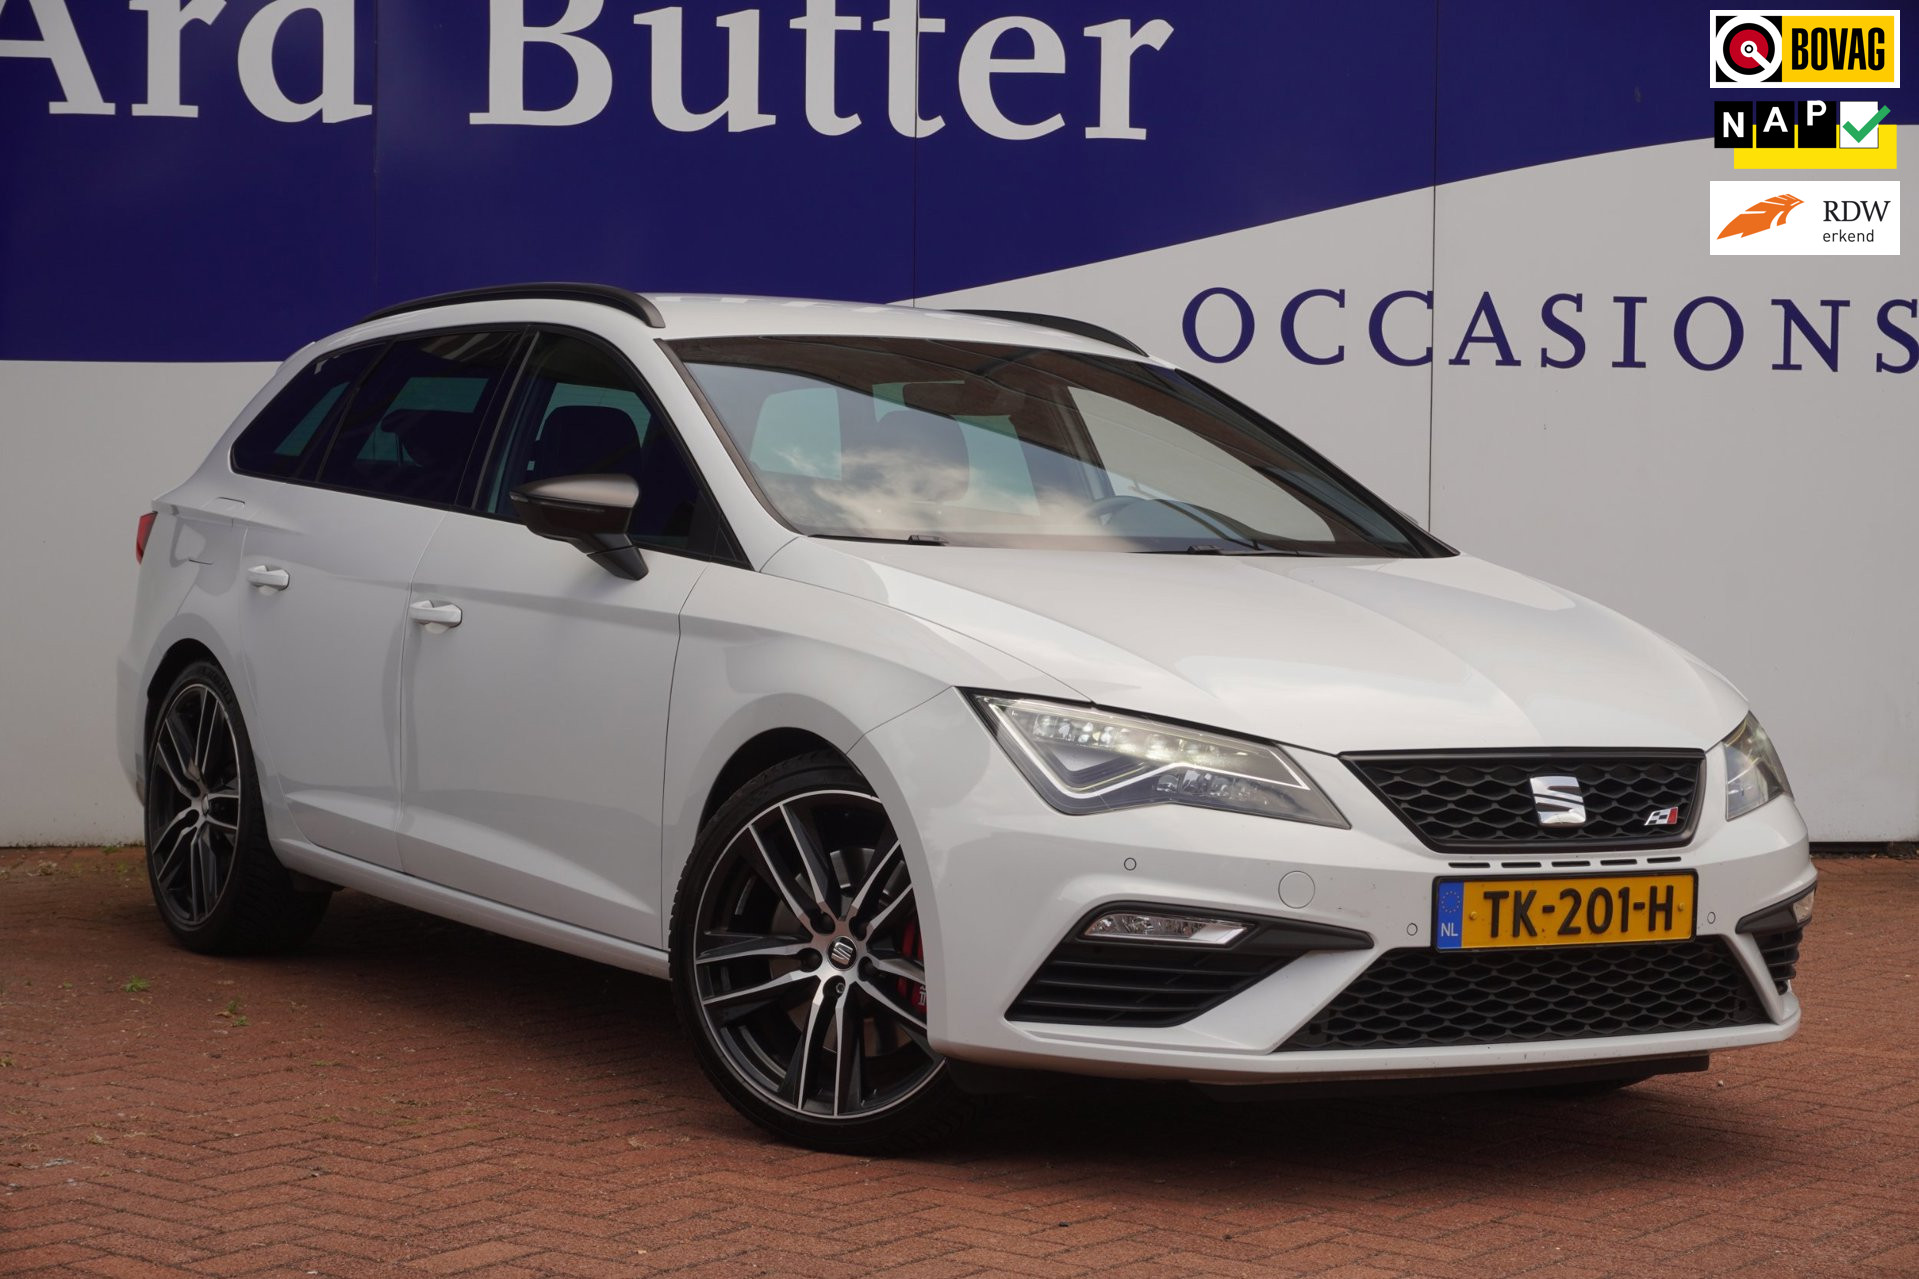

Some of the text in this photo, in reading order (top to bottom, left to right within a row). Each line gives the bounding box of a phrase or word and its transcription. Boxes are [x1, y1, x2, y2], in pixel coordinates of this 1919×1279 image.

[469, 0, 1176, 141] Butter
[1181, 286, 1919, 374] OCCASIONS
[1440, 921, 1459, 938] NL
[1483, 884, 1674, 939] TK-201-H
